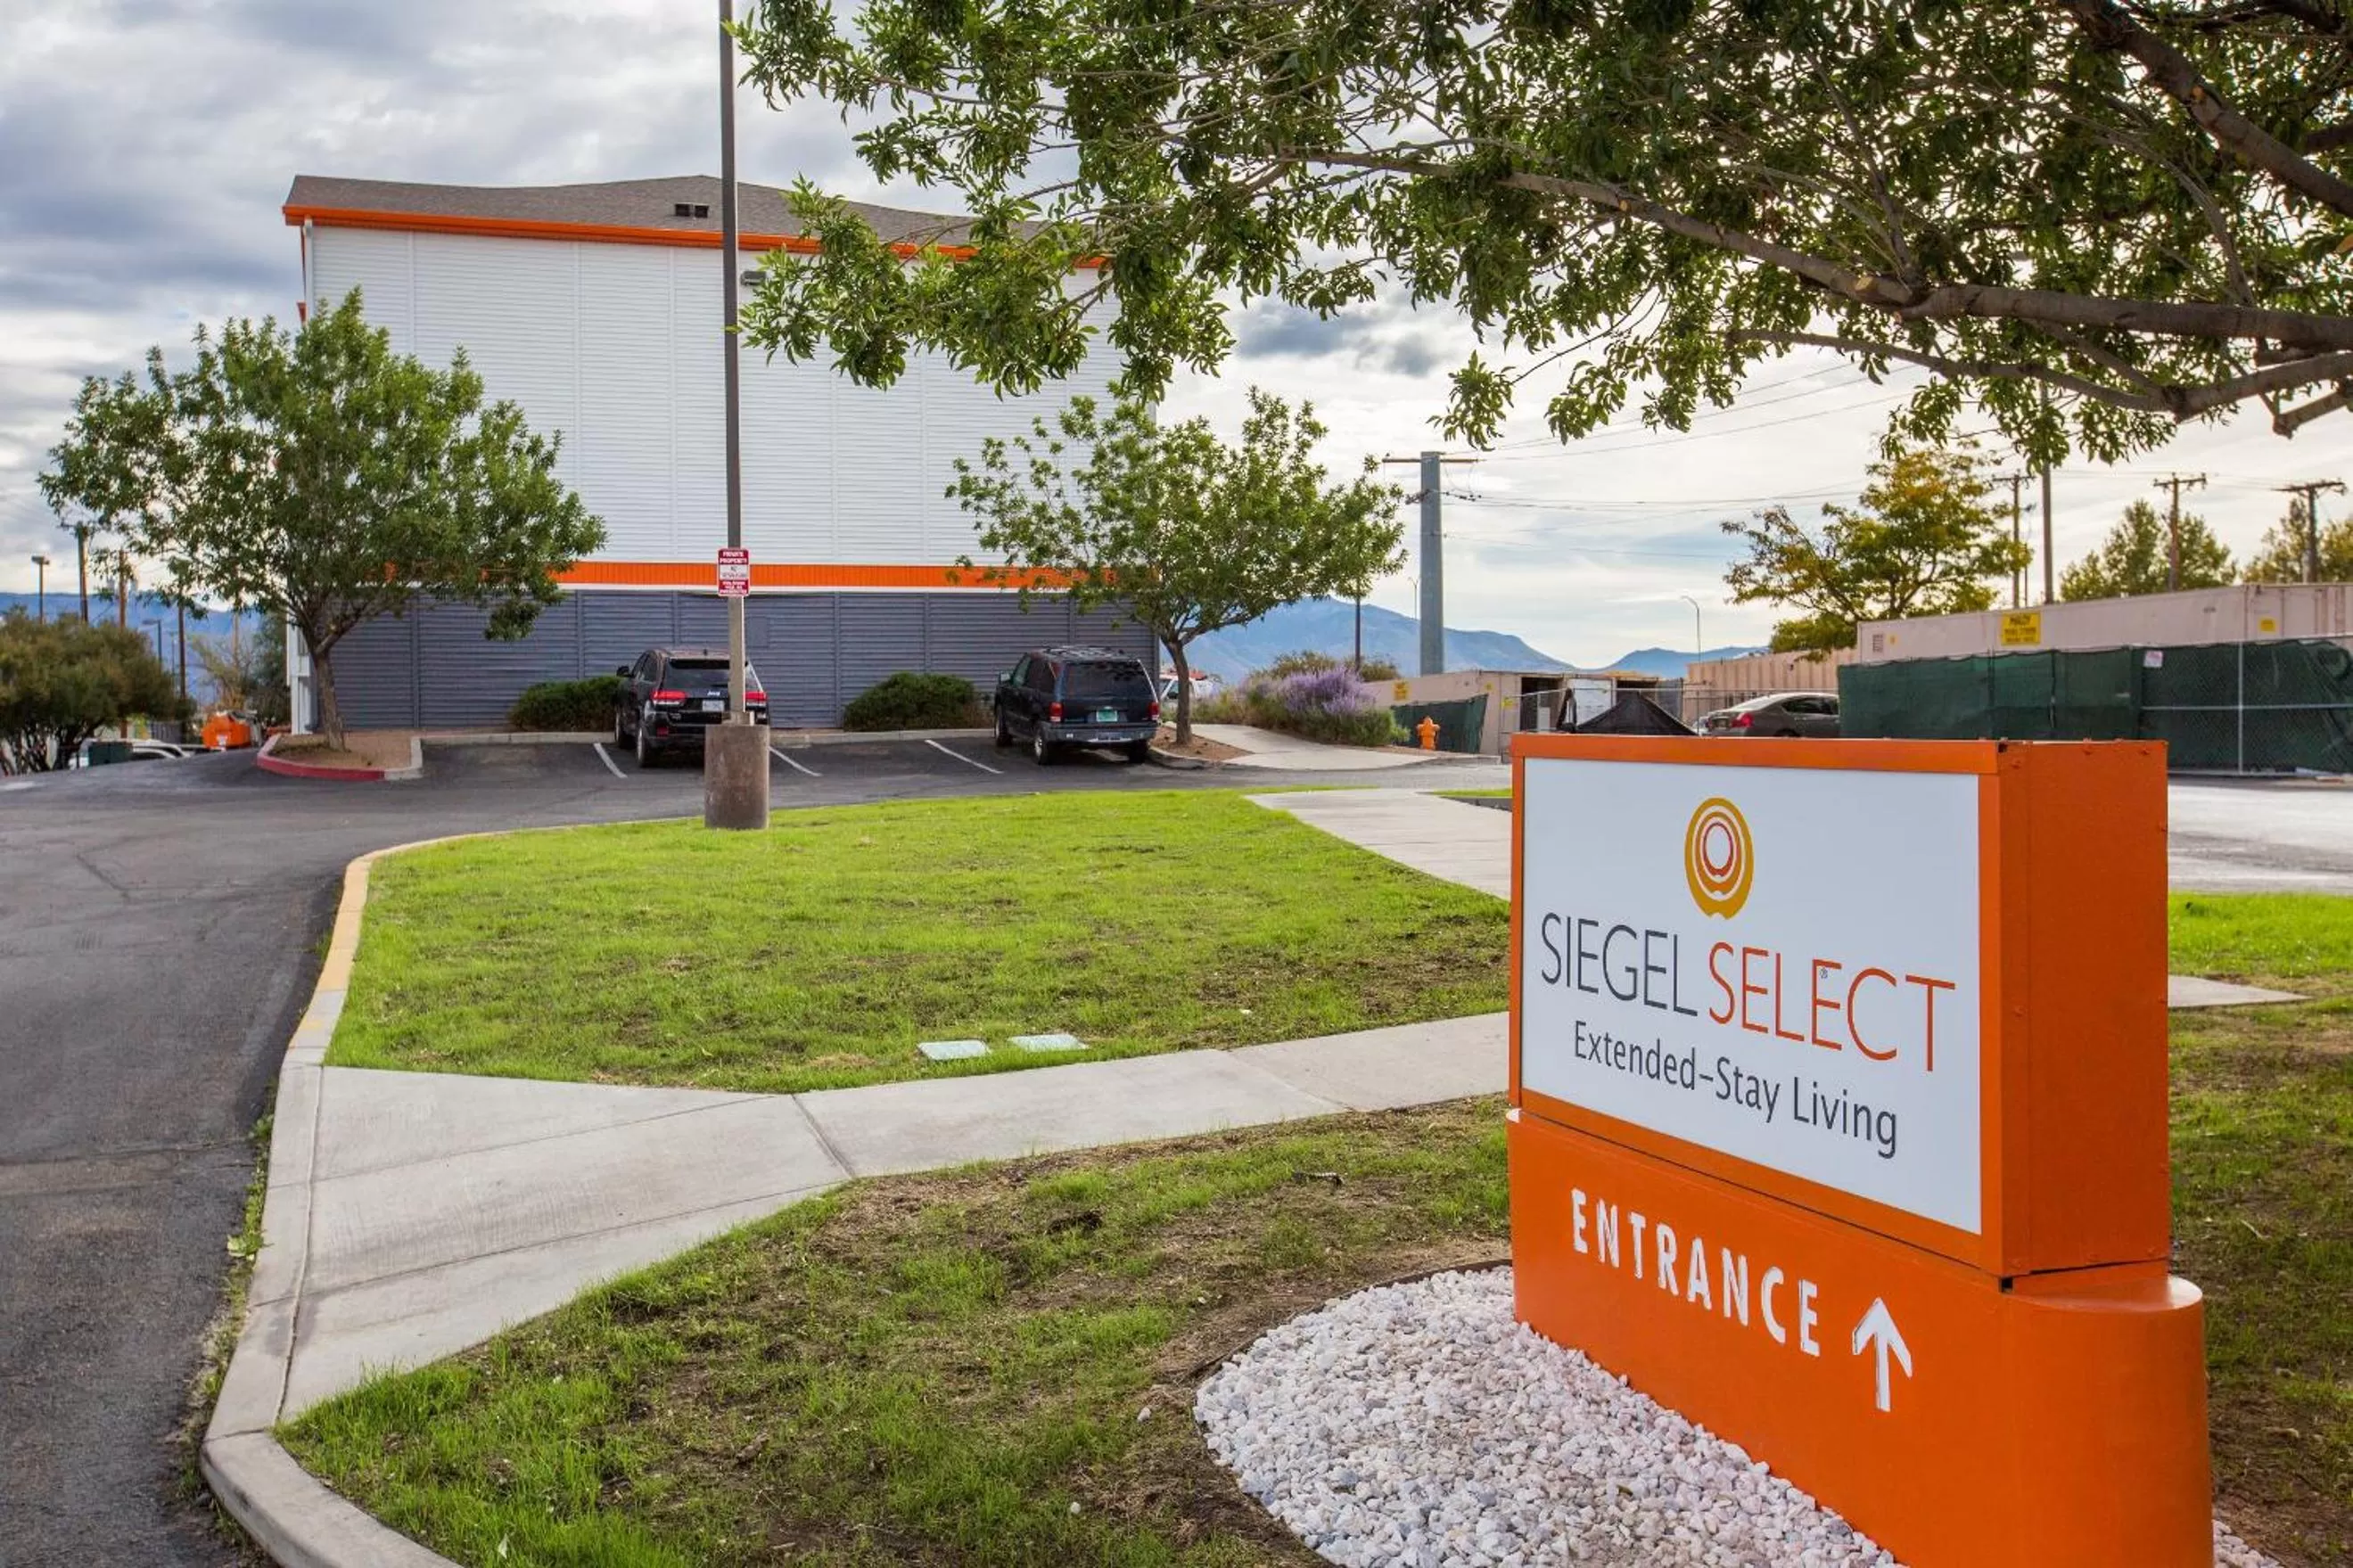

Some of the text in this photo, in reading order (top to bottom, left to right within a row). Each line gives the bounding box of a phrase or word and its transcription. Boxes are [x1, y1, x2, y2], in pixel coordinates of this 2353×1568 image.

[1541, 911, 1955, 1071] SIEGEL SELECT
[1792, 1075, 1897, 1160] Living
[1571, 1187, 1821, 1357] ENTRANCE
